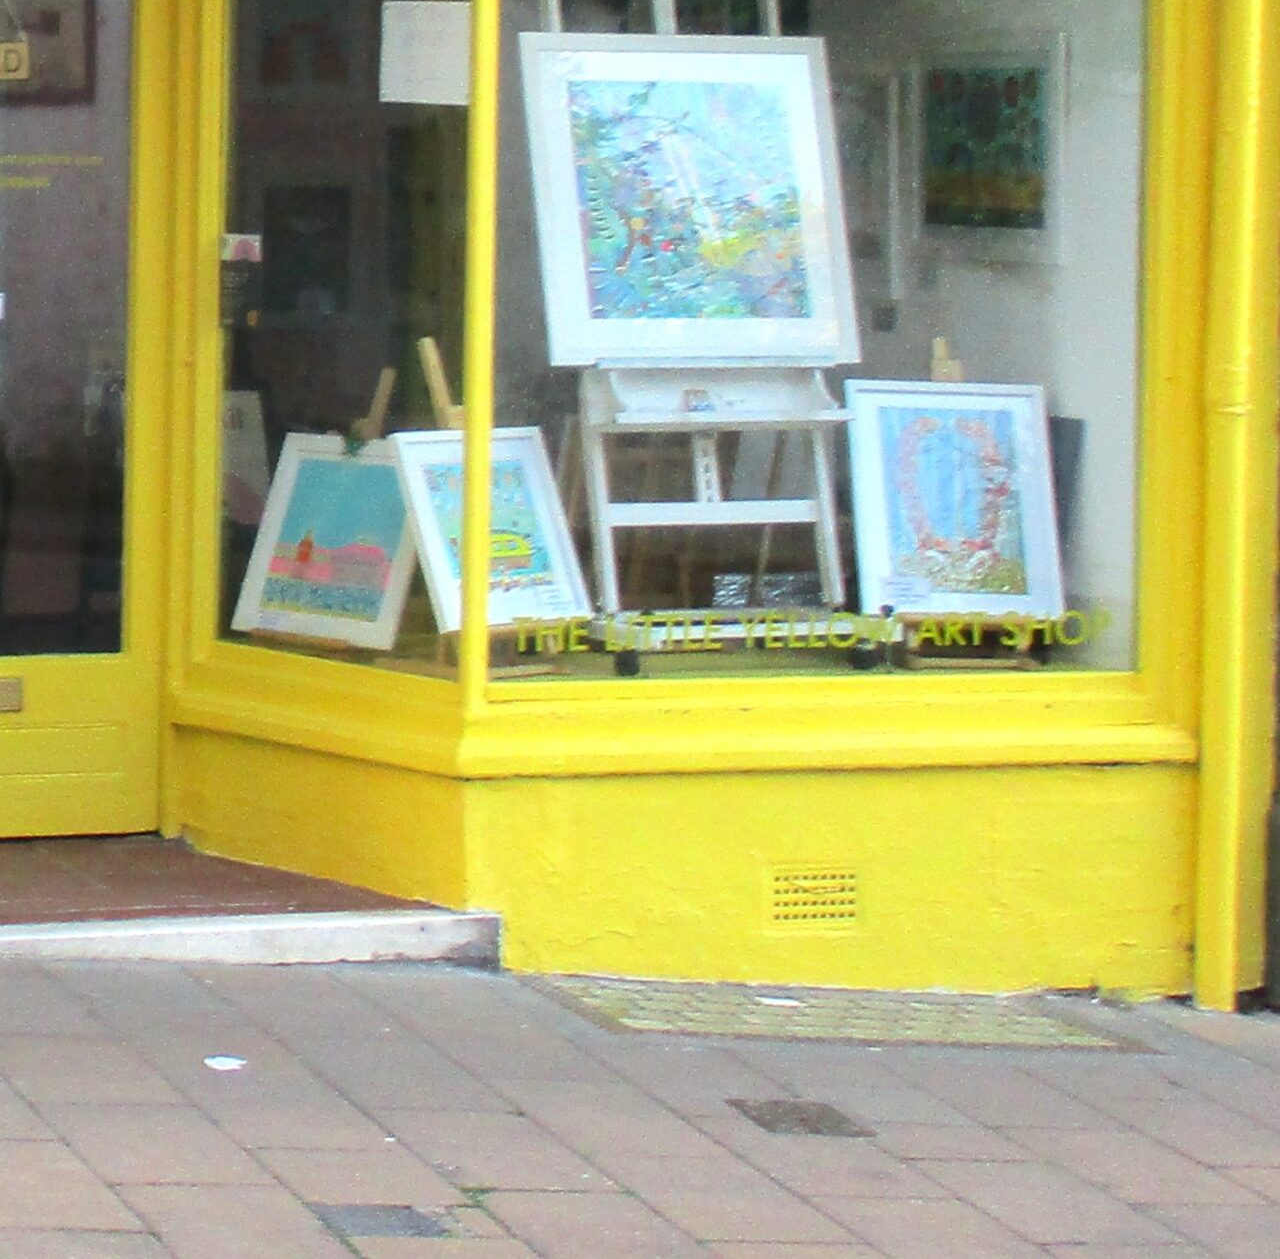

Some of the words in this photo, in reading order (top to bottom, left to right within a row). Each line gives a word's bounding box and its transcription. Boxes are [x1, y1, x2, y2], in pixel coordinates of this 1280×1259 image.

[512, 616, 589, 653] THE
[604, 613, 725, 653] LITTLE
[916, 611, 988, 647] ART
[1000, 609, 1111, 647] SHOP
